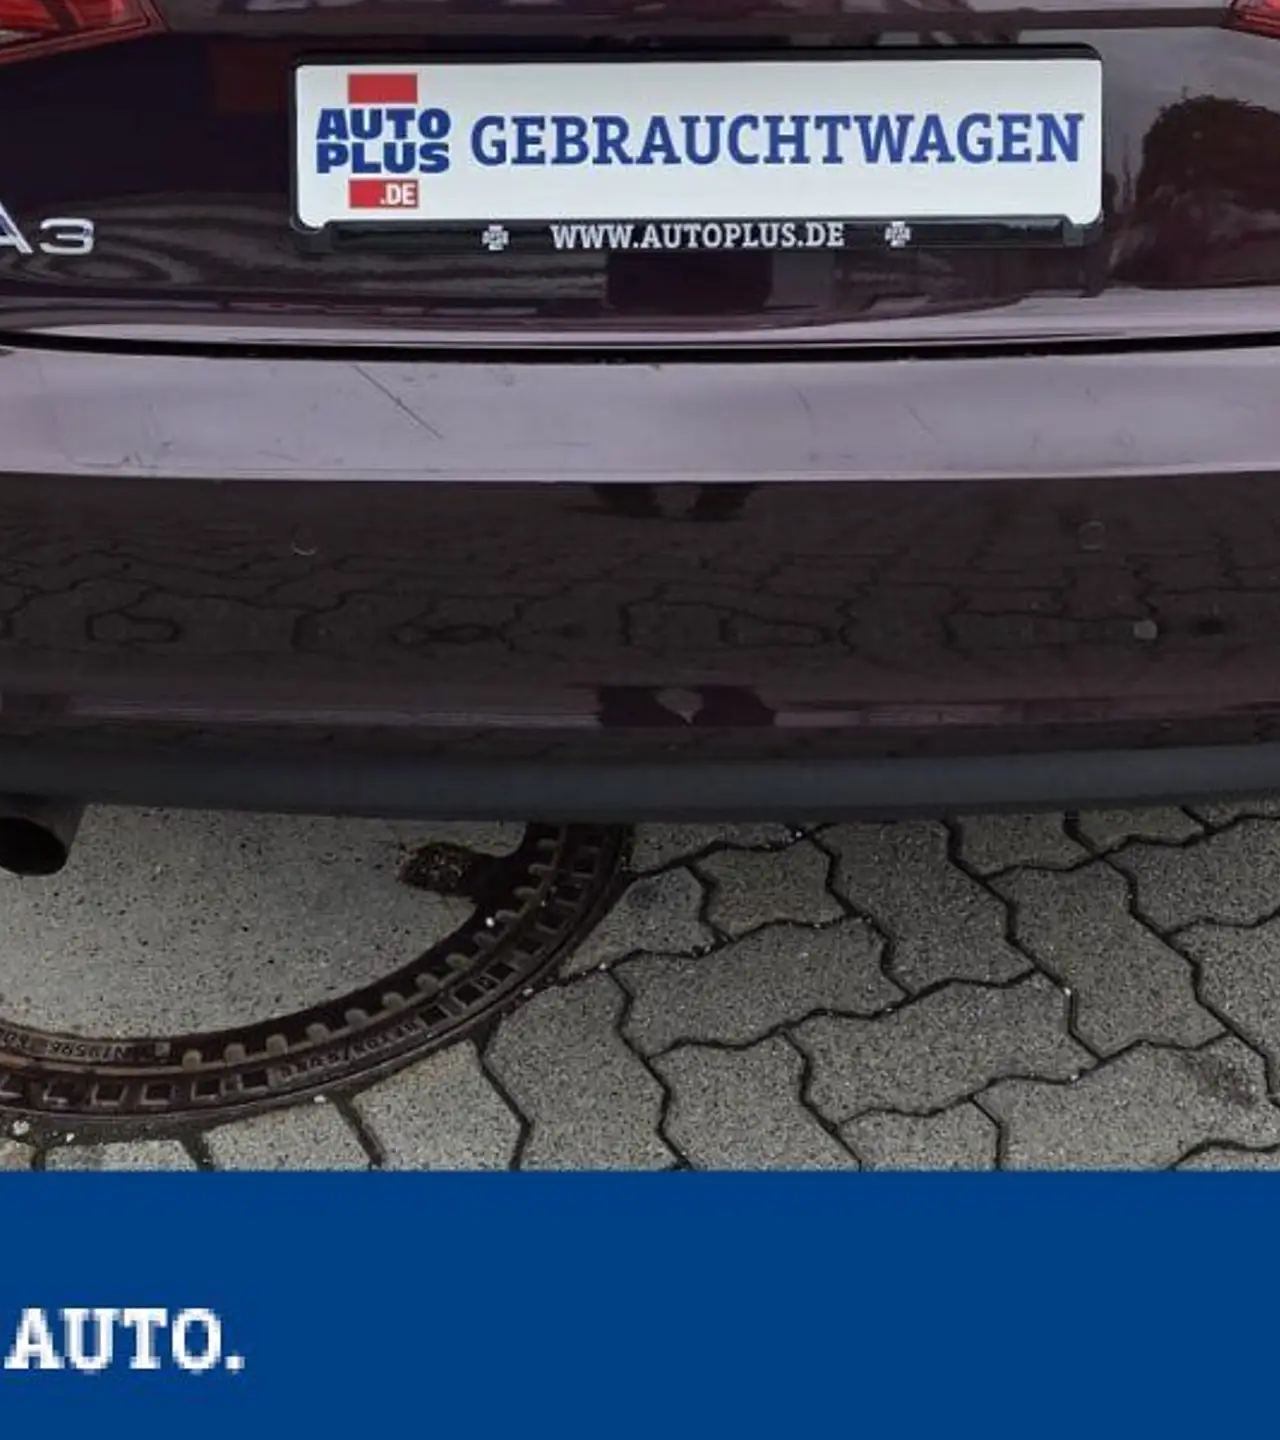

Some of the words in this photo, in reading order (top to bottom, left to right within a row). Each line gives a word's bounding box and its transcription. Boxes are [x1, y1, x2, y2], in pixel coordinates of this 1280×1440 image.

[316, 108, 452, 140] AUTO
[471, 112, 1081, 167] GEBRAUCHTWAGEN
[316, 141, 451, 174] PLUS
[379, 182, 418, 206] .DE
[549, 221, 846, 250] WWW.AUTOPLUS.DE
